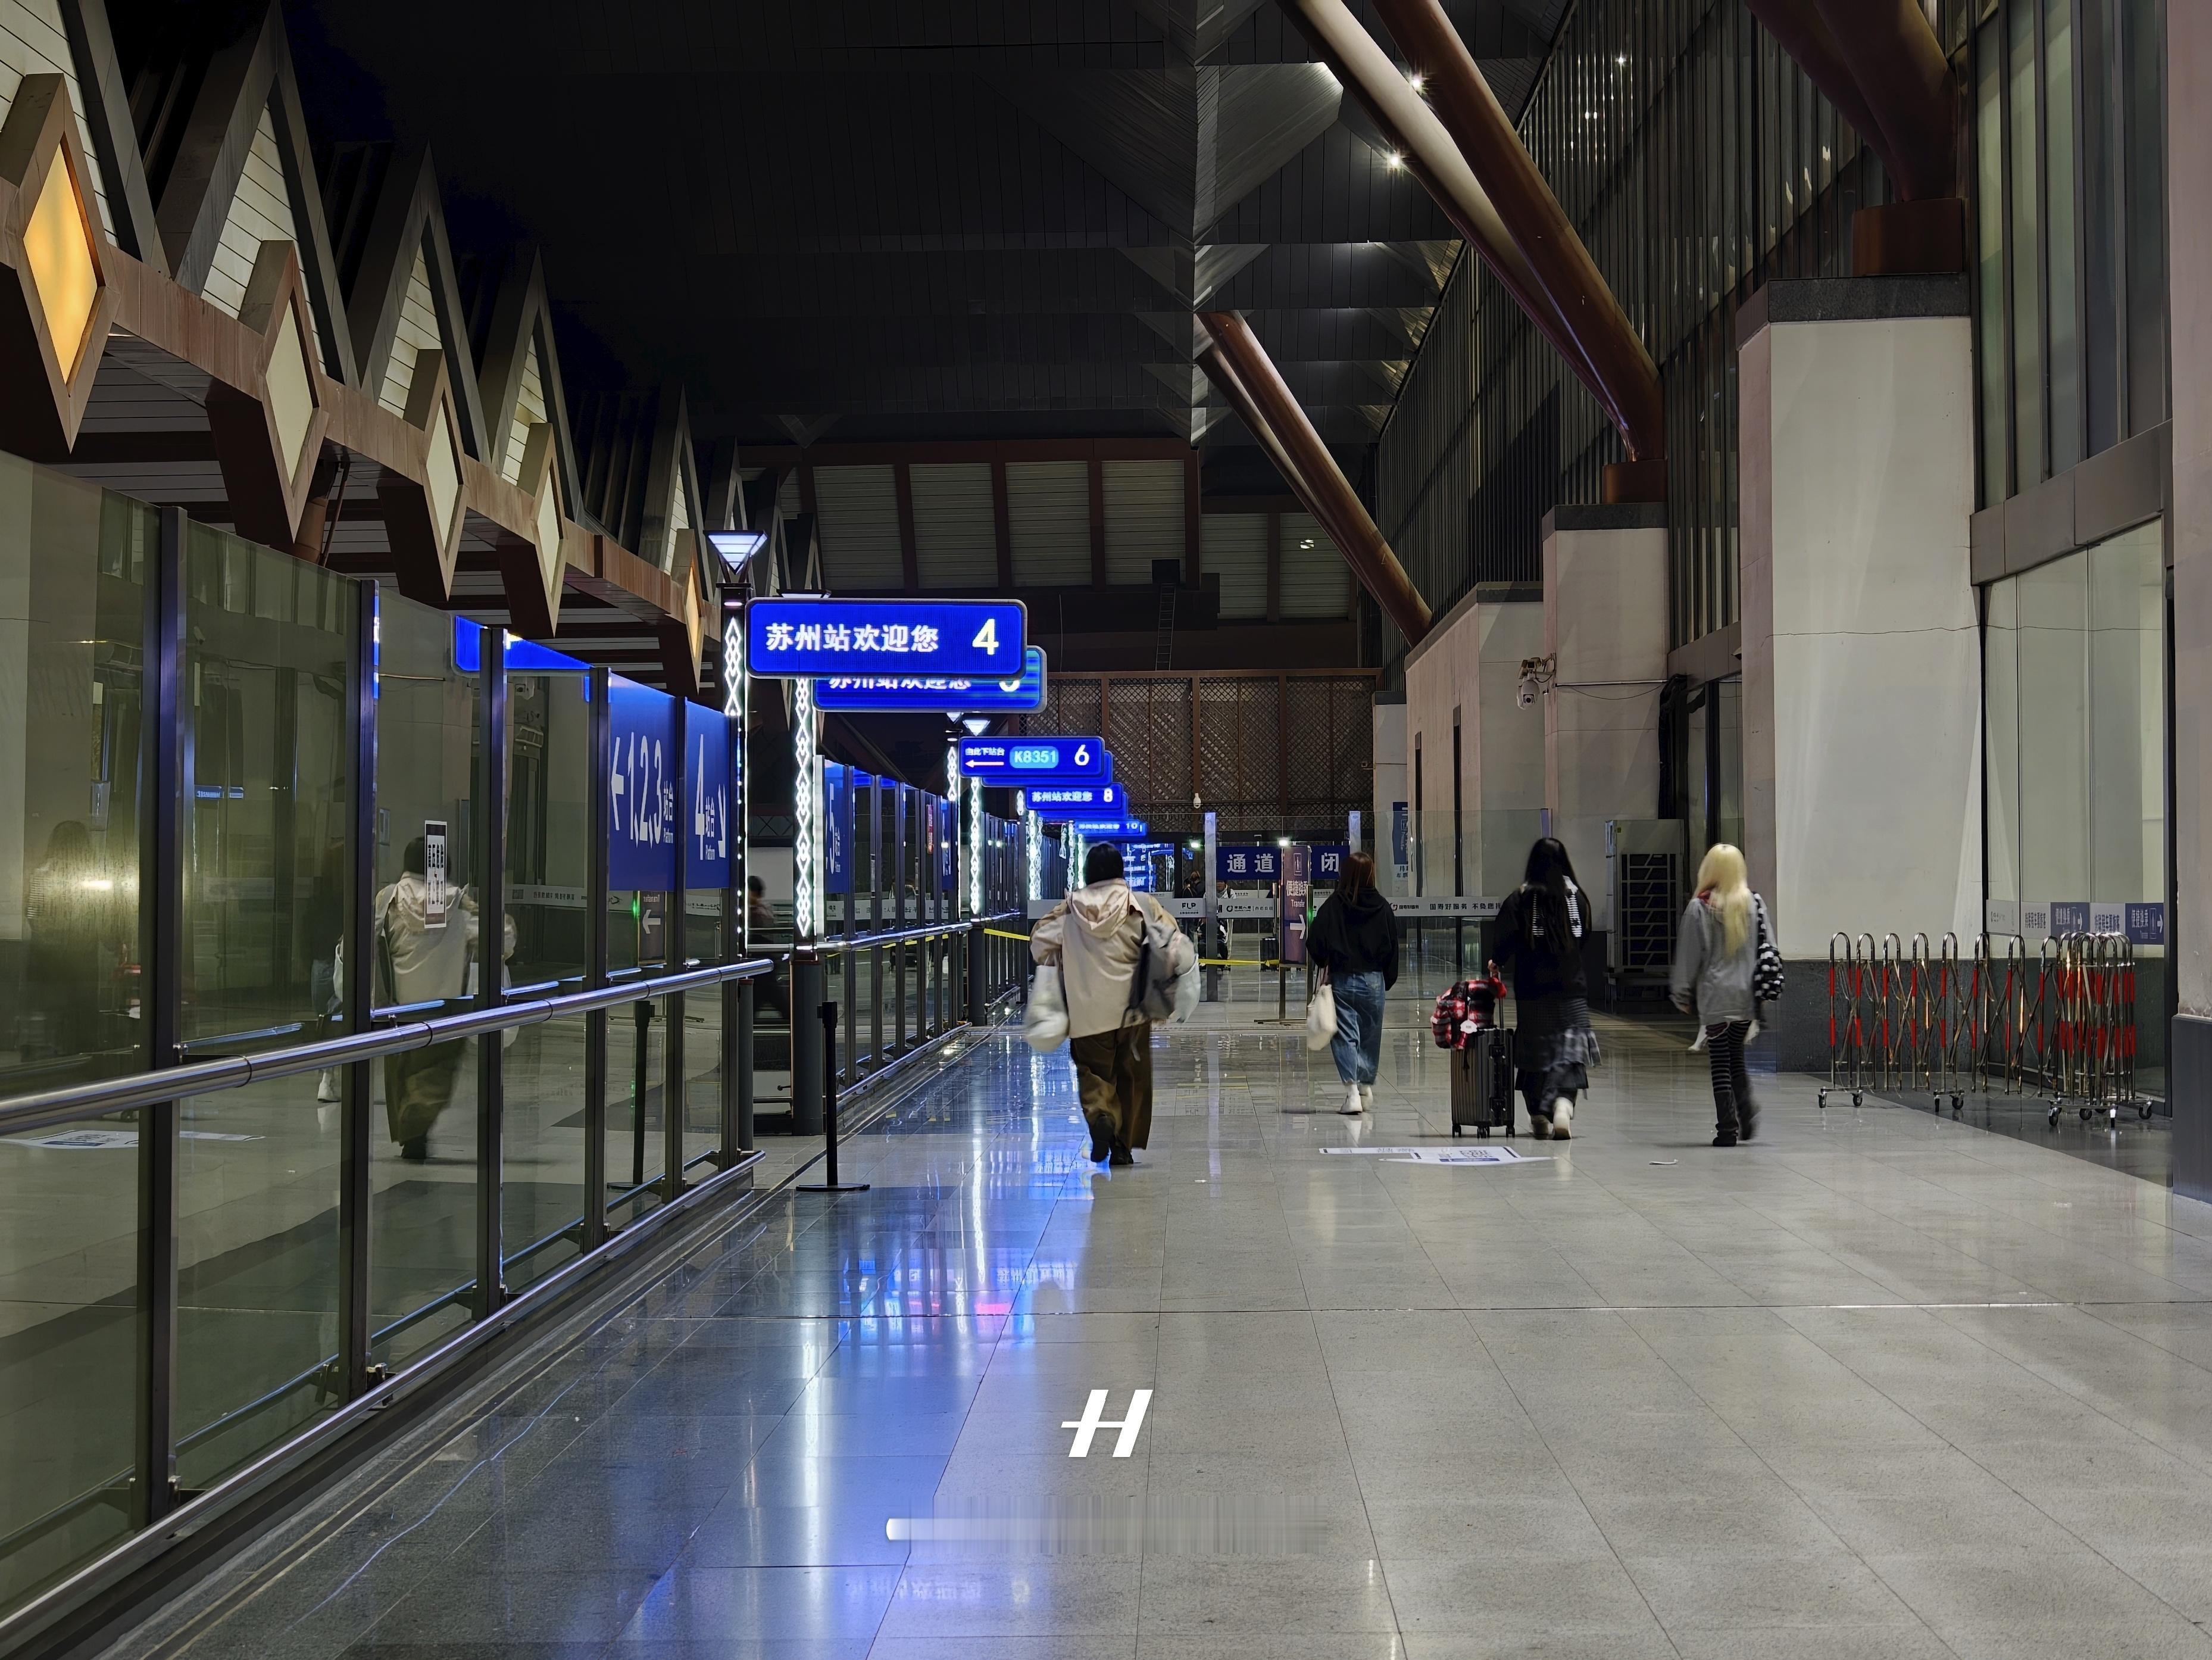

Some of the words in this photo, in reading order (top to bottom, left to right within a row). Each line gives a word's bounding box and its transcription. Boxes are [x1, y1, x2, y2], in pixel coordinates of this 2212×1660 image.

[765, 622, 939, 653] 苏州站欢迎您
[972, 618, 999, 656] 4
[1014, 750, 1057, 763] K8351
[1074, 744, 1090, 766] 6
[663, 780, 674, 821] 站台
[695, 734, 705, 860] 4
[1031, 791, 1093, 802] 苏州站欢迎您
[1103, 787, 1113, 803] 8
[705, 795, 715, 838] 站台
[1227, 853, 1339, 873] 通道闭
